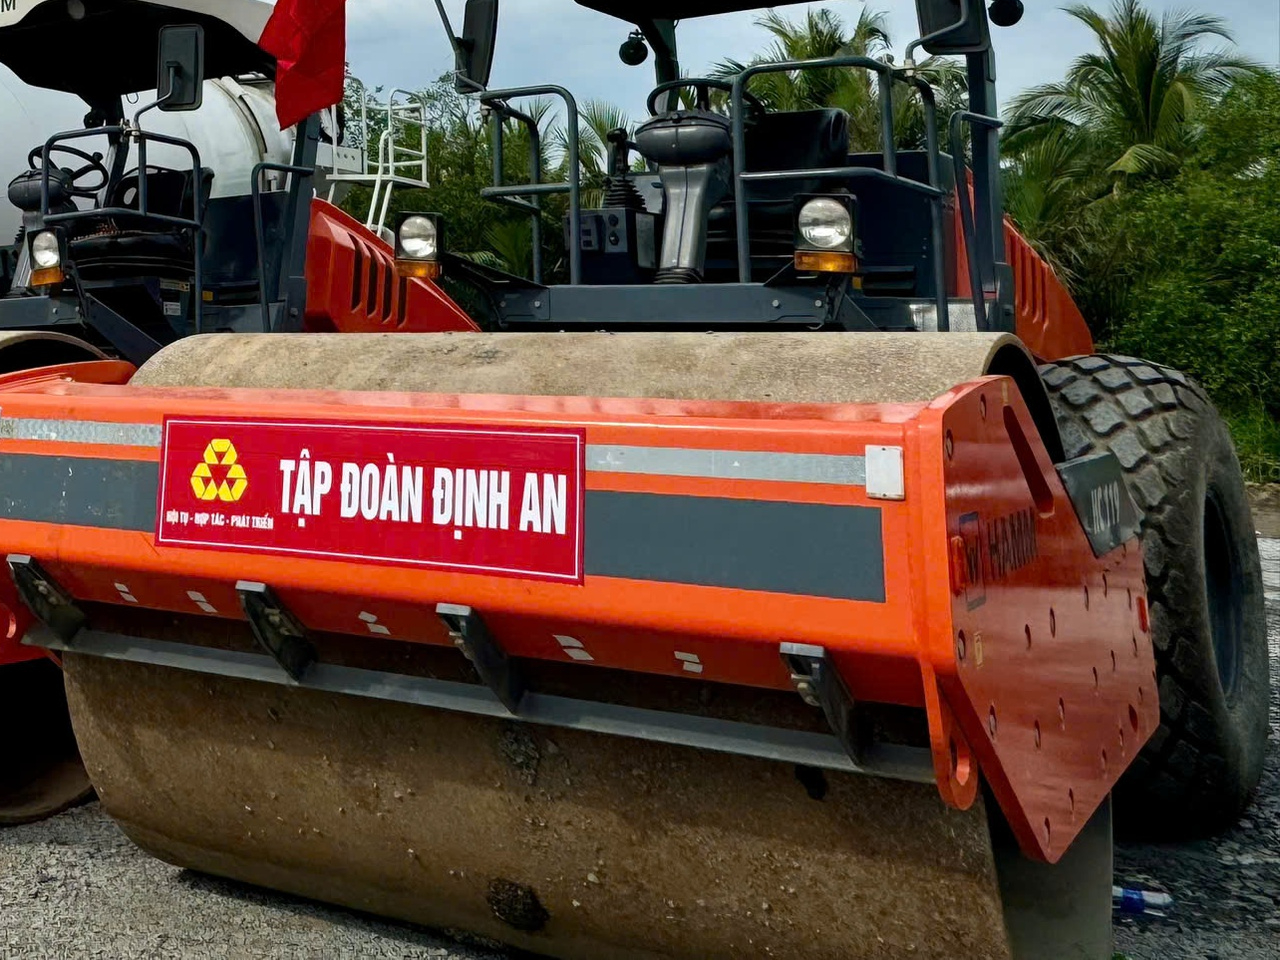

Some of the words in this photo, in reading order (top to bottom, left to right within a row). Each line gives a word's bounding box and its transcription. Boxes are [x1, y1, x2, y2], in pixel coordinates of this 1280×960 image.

[279, 448, 332, 527] TẬP
[340, 452, 423, 523] ĐOÀN
[432, 467, 510, 540] ĐỊNH
[520, 473, 567, 535] AN
